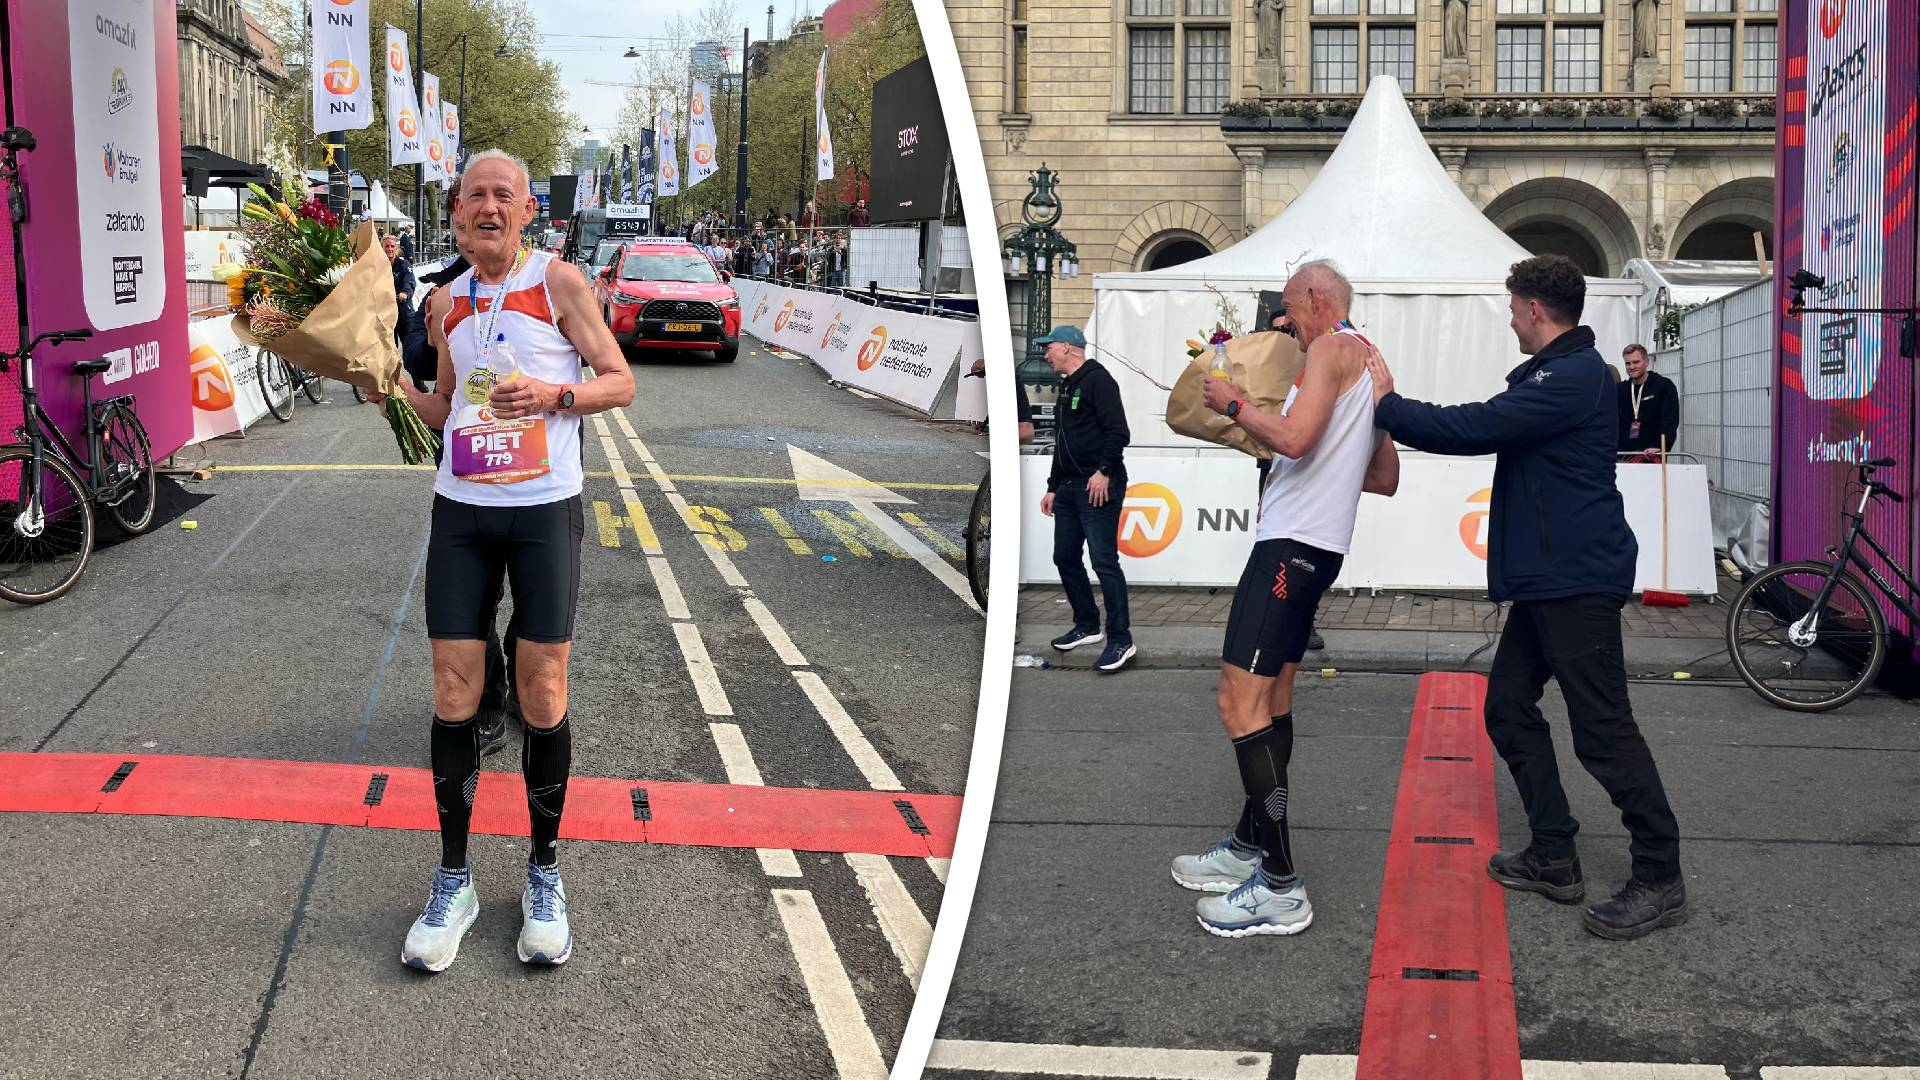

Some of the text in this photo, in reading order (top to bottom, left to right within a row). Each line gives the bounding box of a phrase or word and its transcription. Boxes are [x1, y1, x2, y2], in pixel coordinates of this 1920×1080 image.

[328, 11, 353, 27] NN
[96, 14, 136, 51] amazfit
[330, 101, 356, 114] NN
[403, 142, 420, 152] NN
[897, 125, 919, 149] STOX
[106, 210, 145, 232] zalando
[888, 338, 928, 357] nationale
[879, 354, 932, 379] nederlanden
[471, 431, 523, 453] PIET
[485, 452, 513, 467] 779
[1197, 508, 1250, 532] NN
